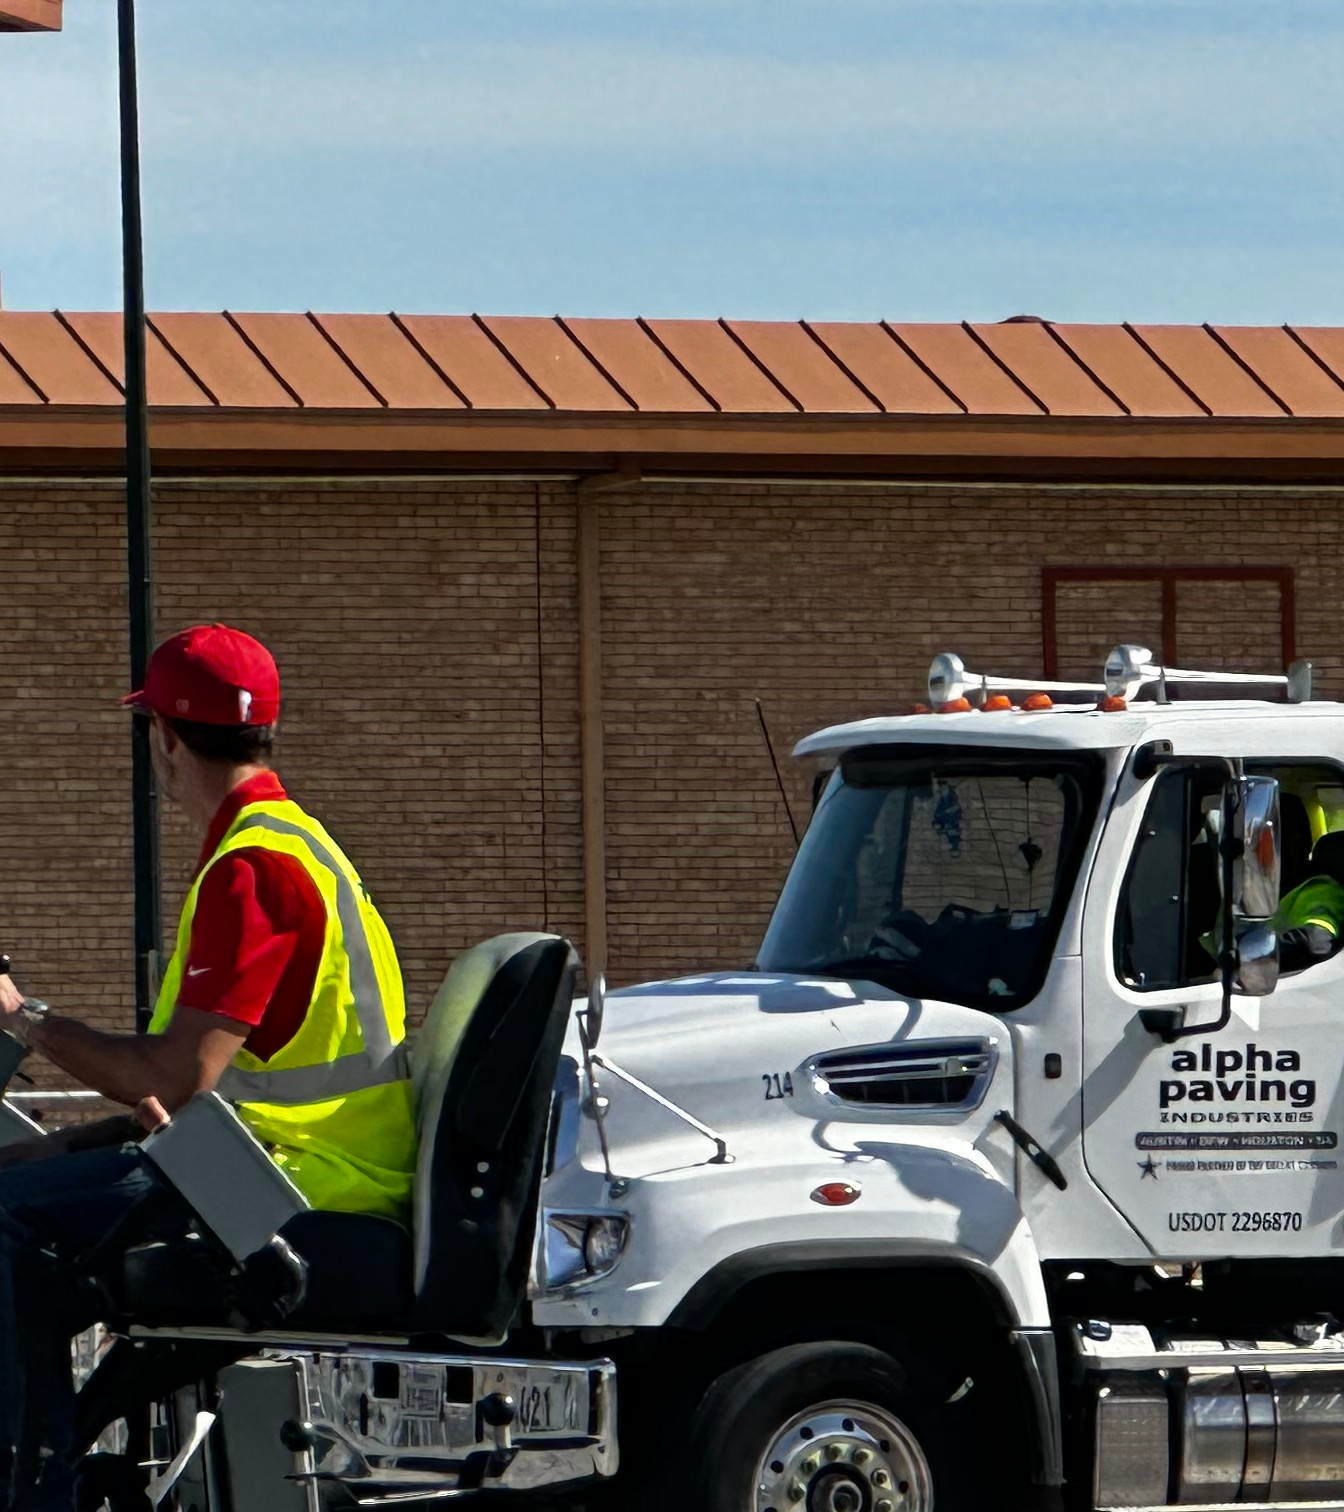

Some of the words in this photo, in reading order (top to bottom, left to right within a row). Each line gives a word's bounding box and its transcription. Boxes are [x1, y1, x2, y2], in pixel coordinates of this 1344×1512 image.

[1172, 1043, 1301, 1079] alpha
[760, 1071, 793, 1100] 214
[1159, 1073, 1317, 1109] paving
[1159, 1111, 1314, 1124] INDUSTRIES
[1168, 1212, 1227, 1232] USDOT
[1231, 1212, 1302, 1232] 2296870
